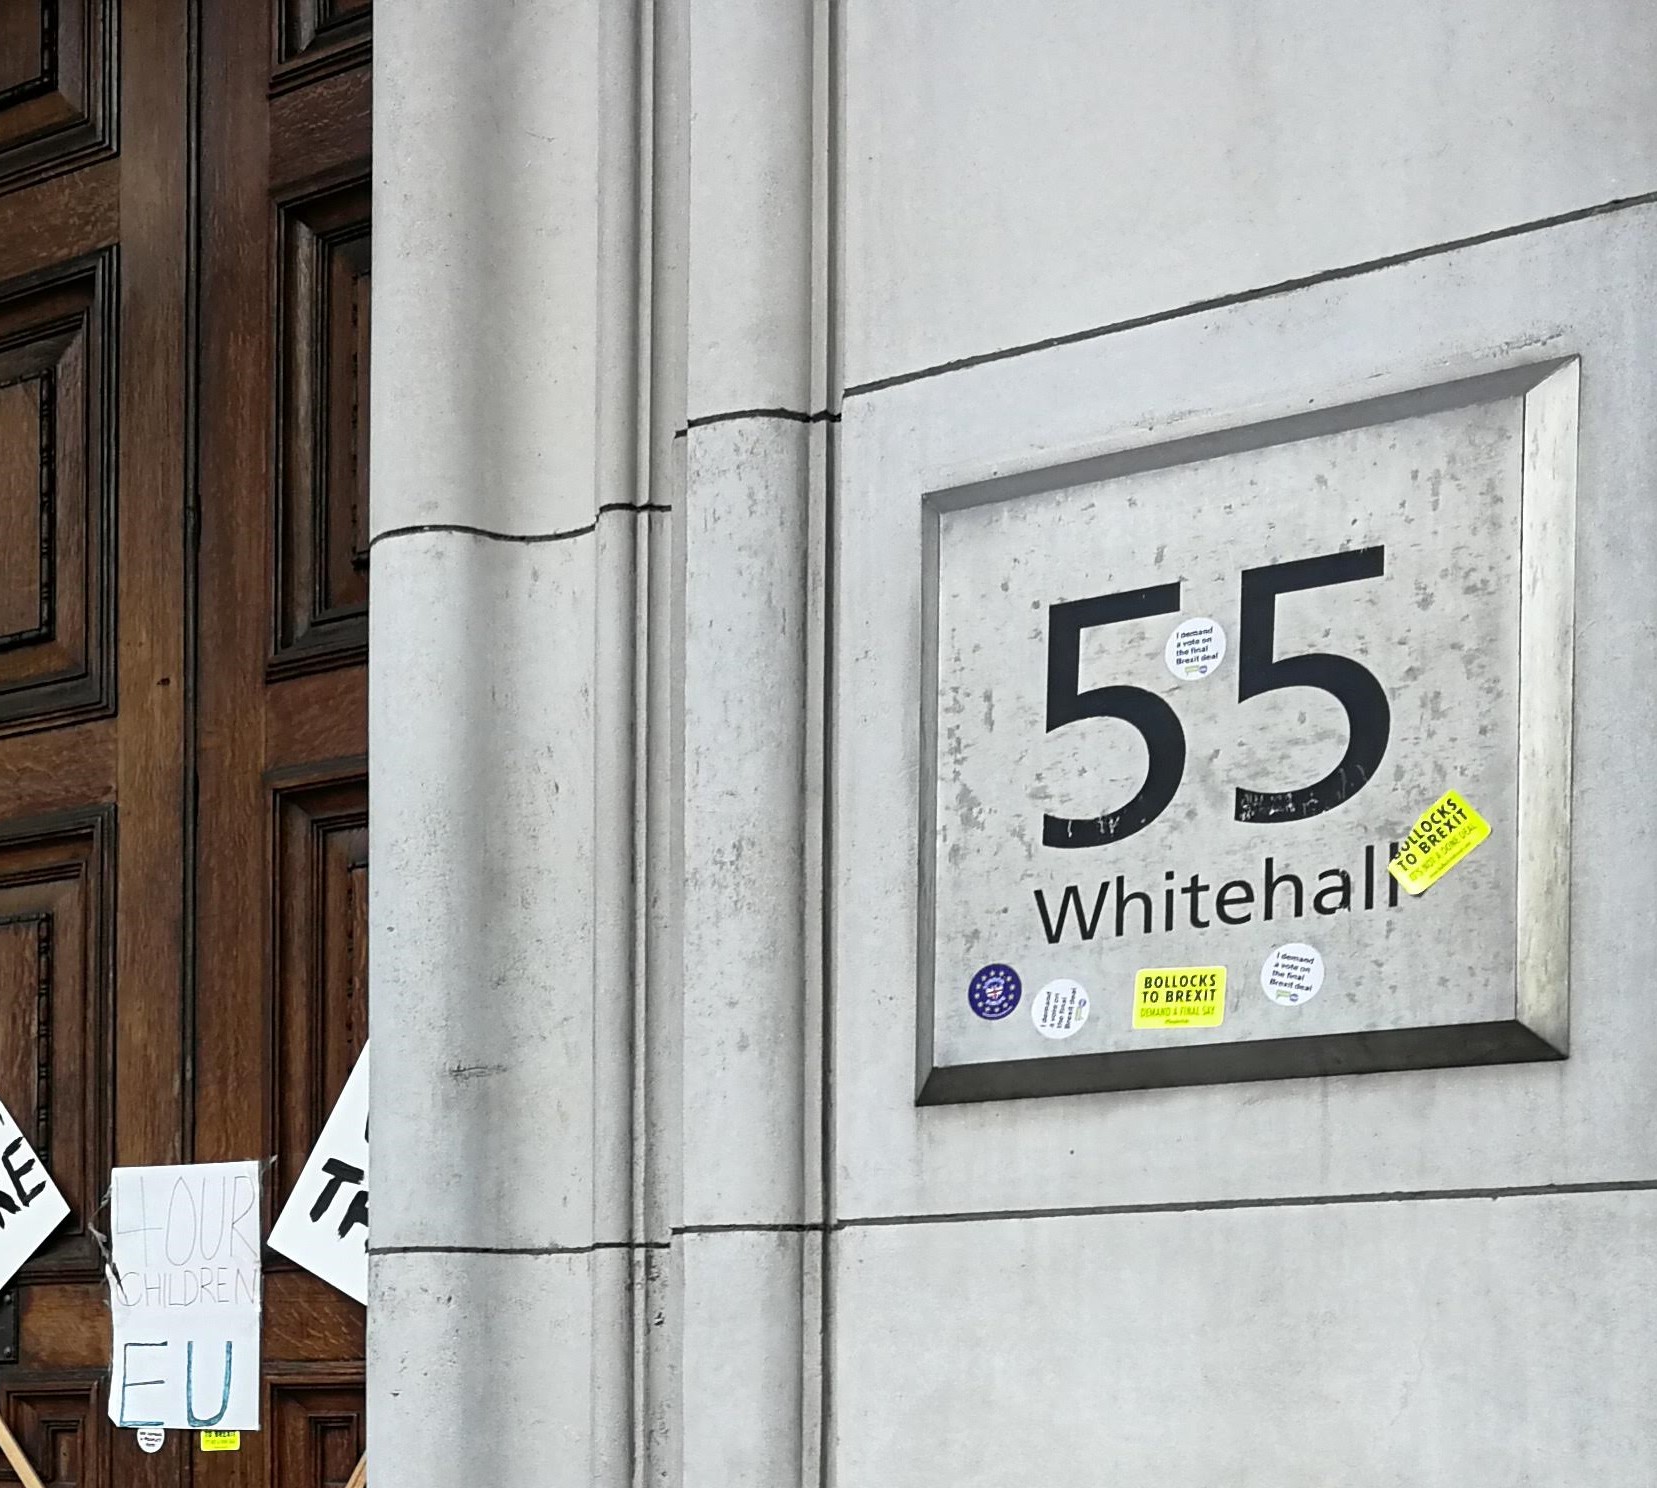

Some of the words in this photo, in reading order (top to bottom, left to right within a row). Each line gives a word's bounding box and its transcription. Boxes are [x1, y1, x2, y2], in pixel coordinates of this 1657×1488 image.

[1042, 544, 1391, 850] 55
[1397, 853, 1417, 871] TO
[1418, 808, 1468, 854] BREXIT
[1033, 841, 1399, 944] Whitehall
[1143, 991, 1159, 1003] TO
[1166, 989, 1216, 1002] BREXIT
[1144, 974, 1216, 989] BOLLOCKS
[116, 1267, 257, 1308] CHILDREN
[120, 1340, 233, 1429] EU
